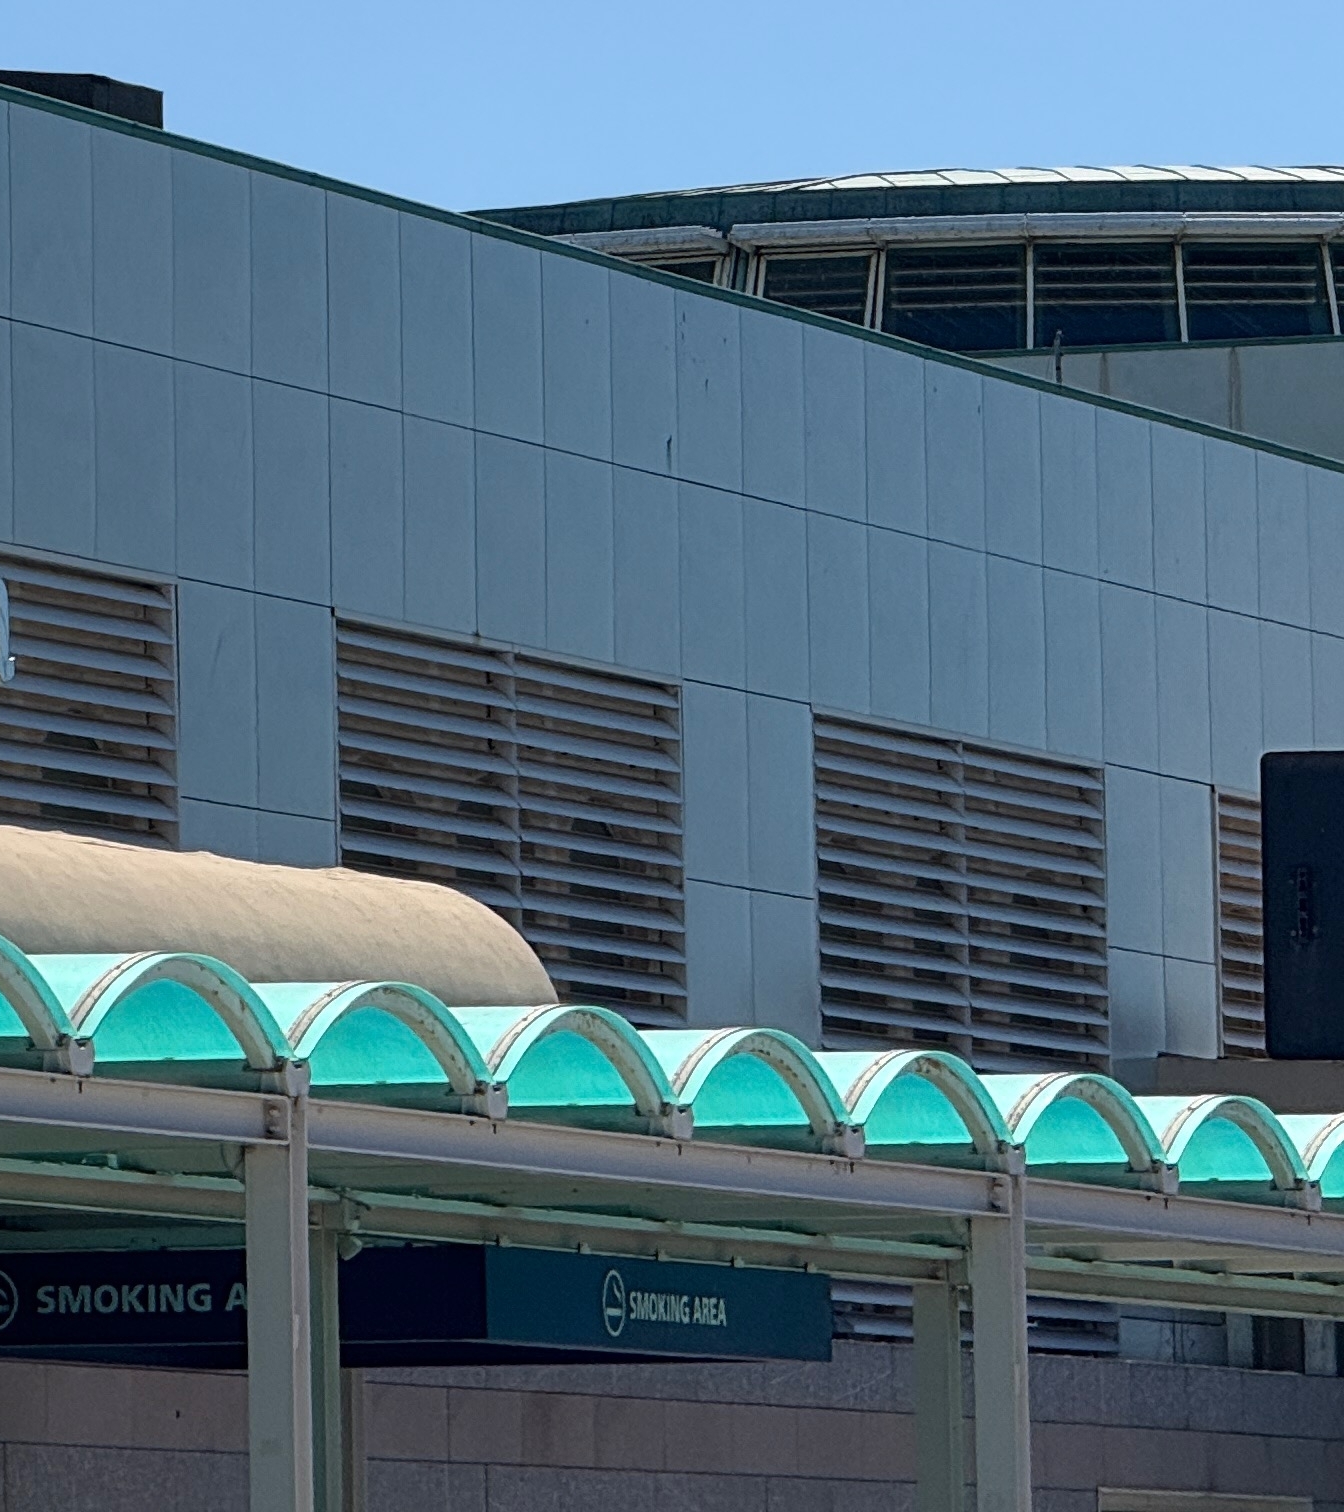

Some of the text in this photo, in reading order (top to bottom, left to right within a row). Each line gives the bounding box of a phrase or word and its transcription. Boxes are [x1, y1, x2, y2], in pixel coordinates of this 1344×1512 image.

[36, 1283, 213, 1314] SMOKING
[629, 1291, 728, 1328] SMOKING AREA
